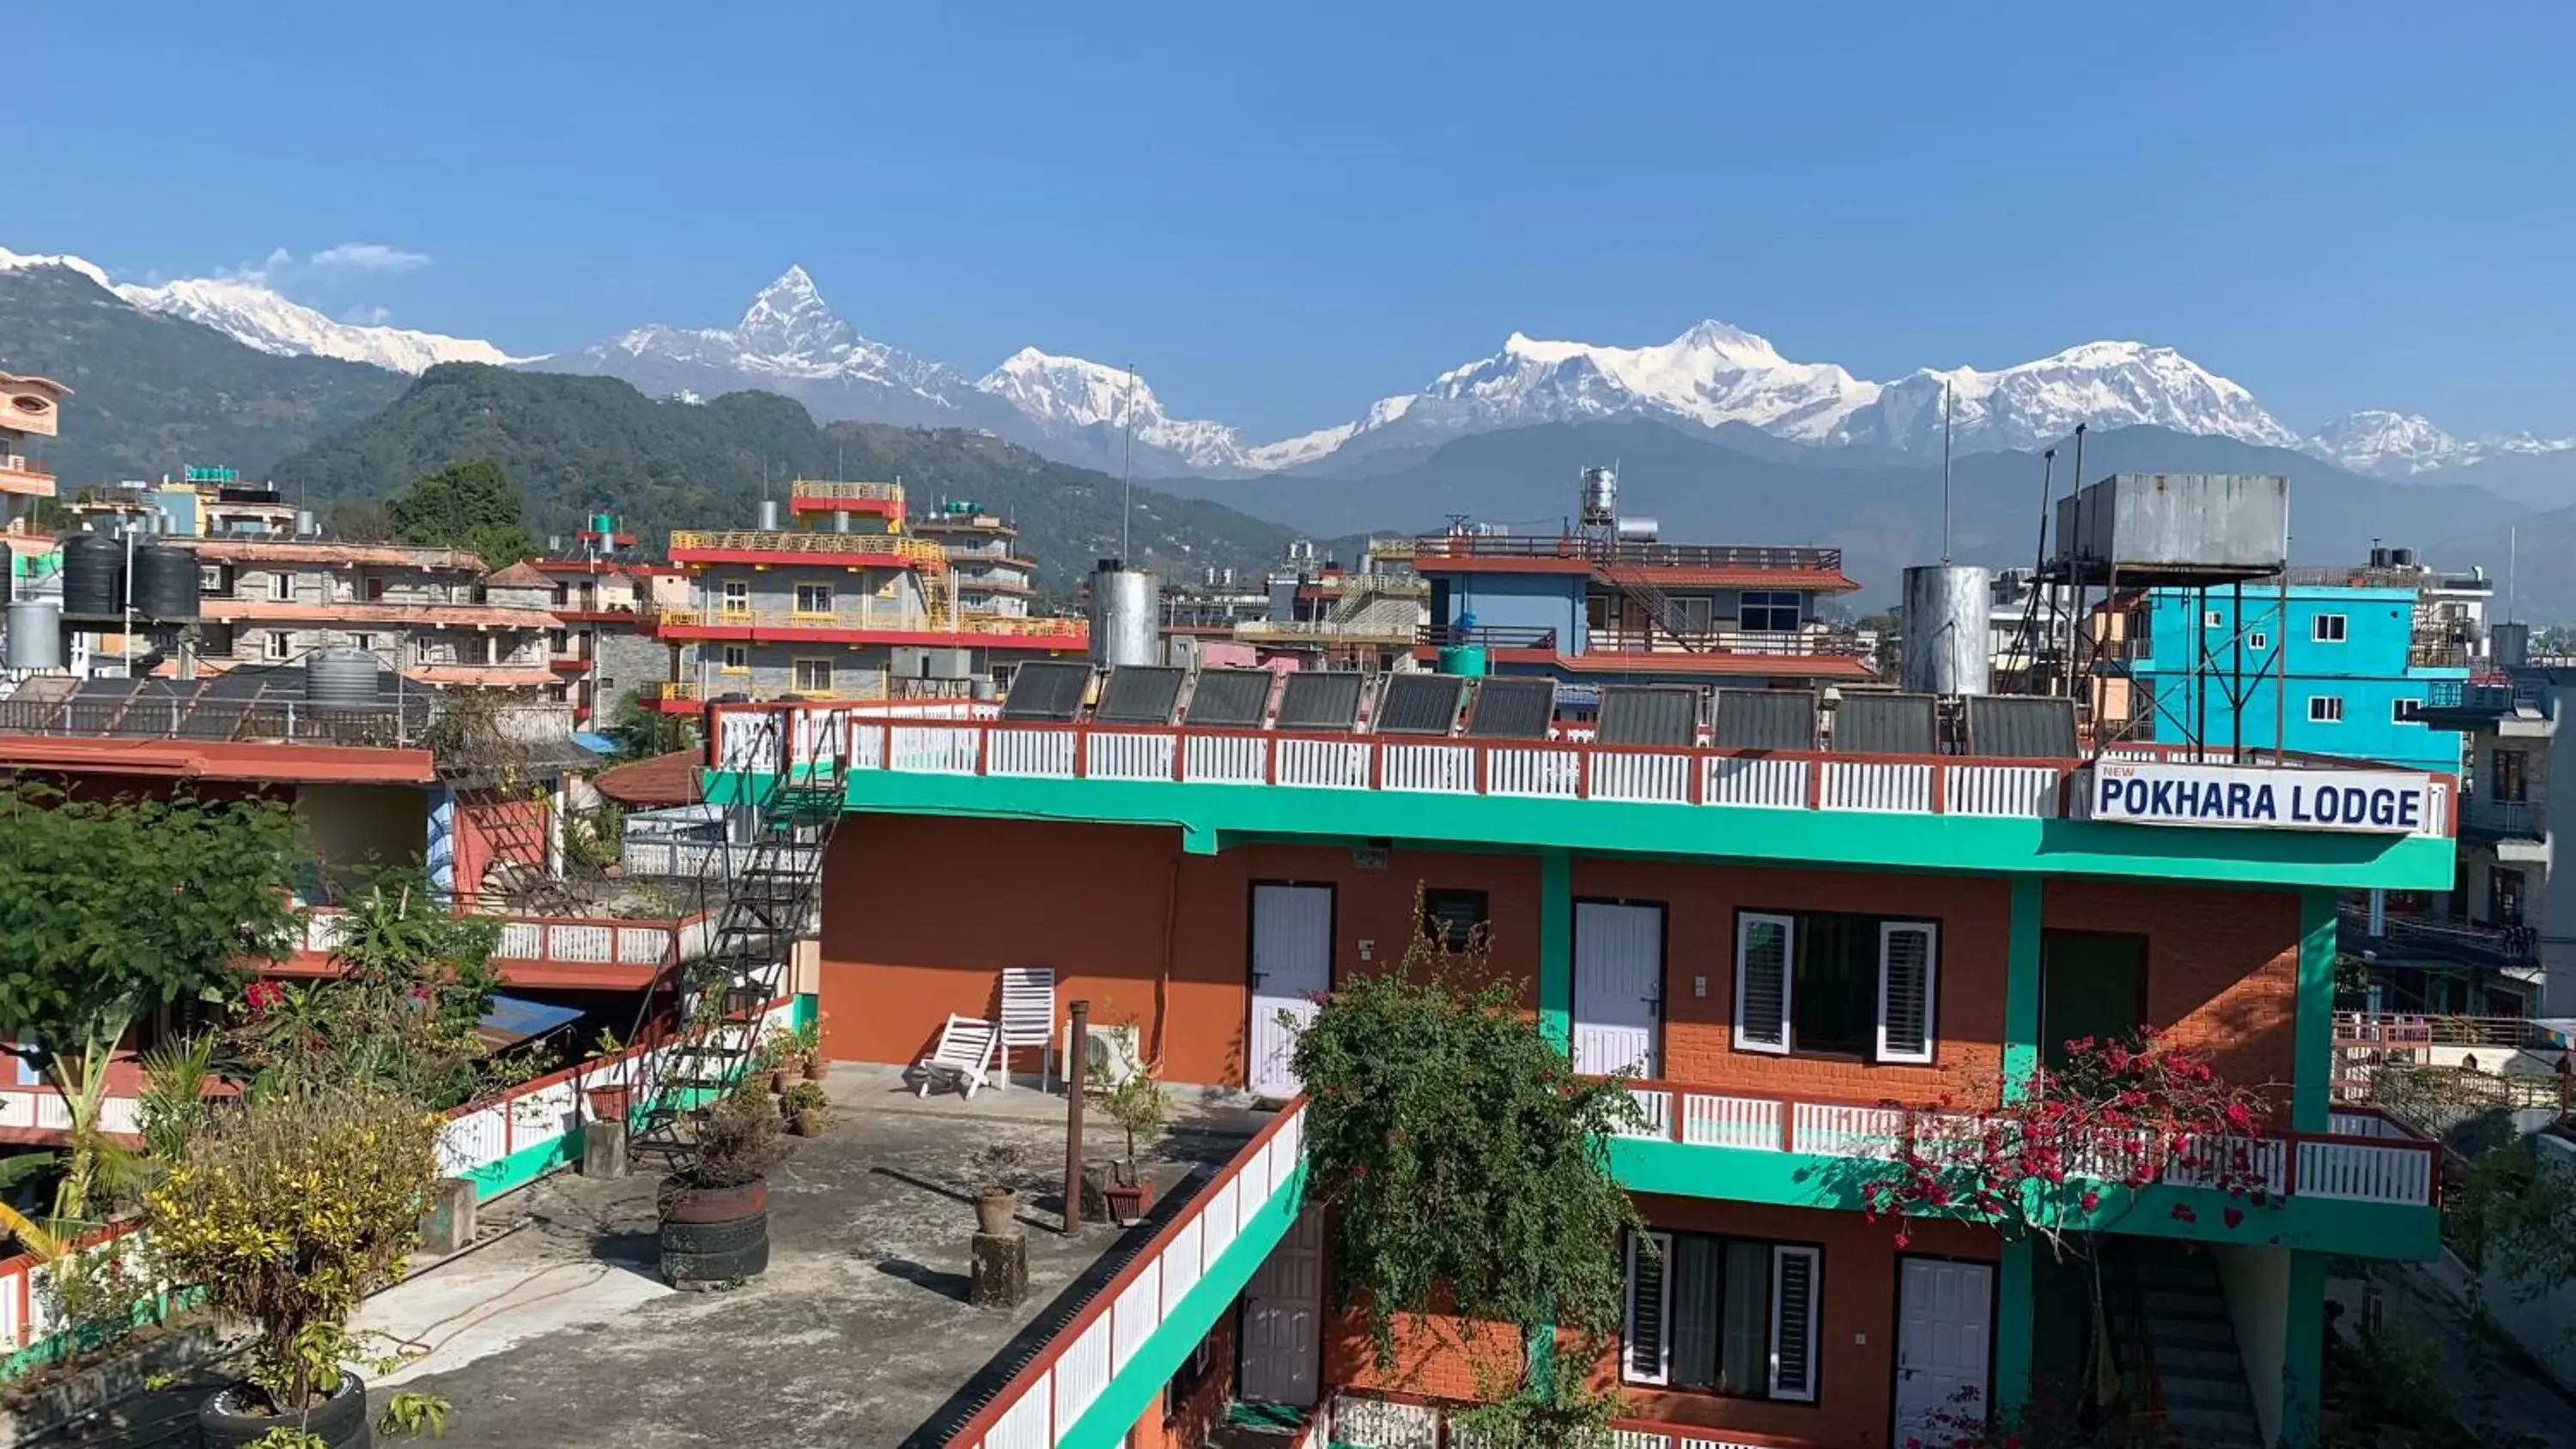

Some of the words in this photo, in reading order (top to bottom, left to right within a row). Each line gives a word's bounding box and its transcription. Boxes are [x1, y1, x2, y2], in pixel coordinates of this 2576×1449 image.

[2103, 766, 2135, 777] NEW
[2100, 778, 2277, 820] POKHARA
[2292, 785, 2421, 826] LODGE
